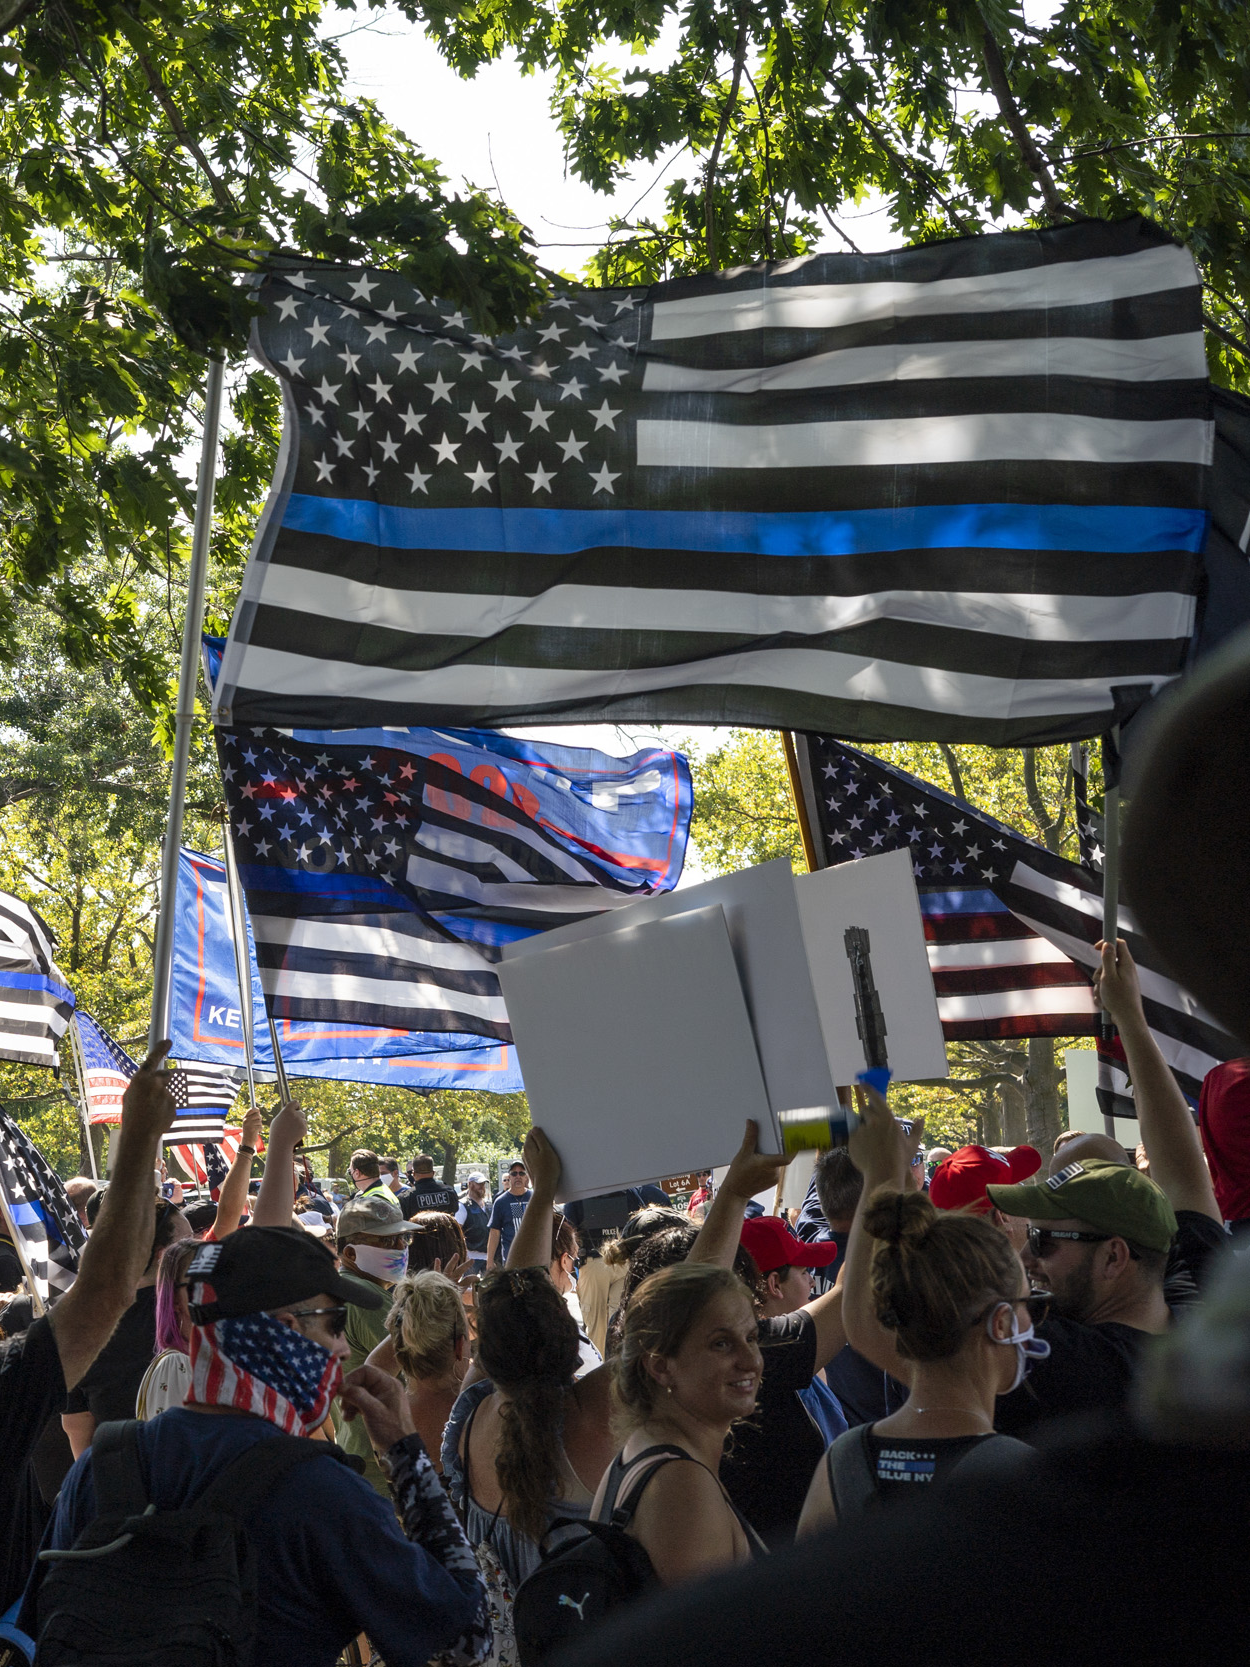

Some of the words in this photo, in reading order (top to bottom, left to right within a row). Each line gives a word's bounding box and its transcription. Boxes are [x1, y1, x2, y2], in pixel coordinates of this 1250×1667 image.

[669, 1180, 680, 1188] Lot
[419, 1193, 448, 1207] POLICE
[602, 1228, 617, 1236] POLICE
[880, 1450, 916, 1460] BACK
[879, 1460, 906, 1470] THE
[878, 1470, 912, 1481] BLUE
[914, 1473, 934, 1482] NY
